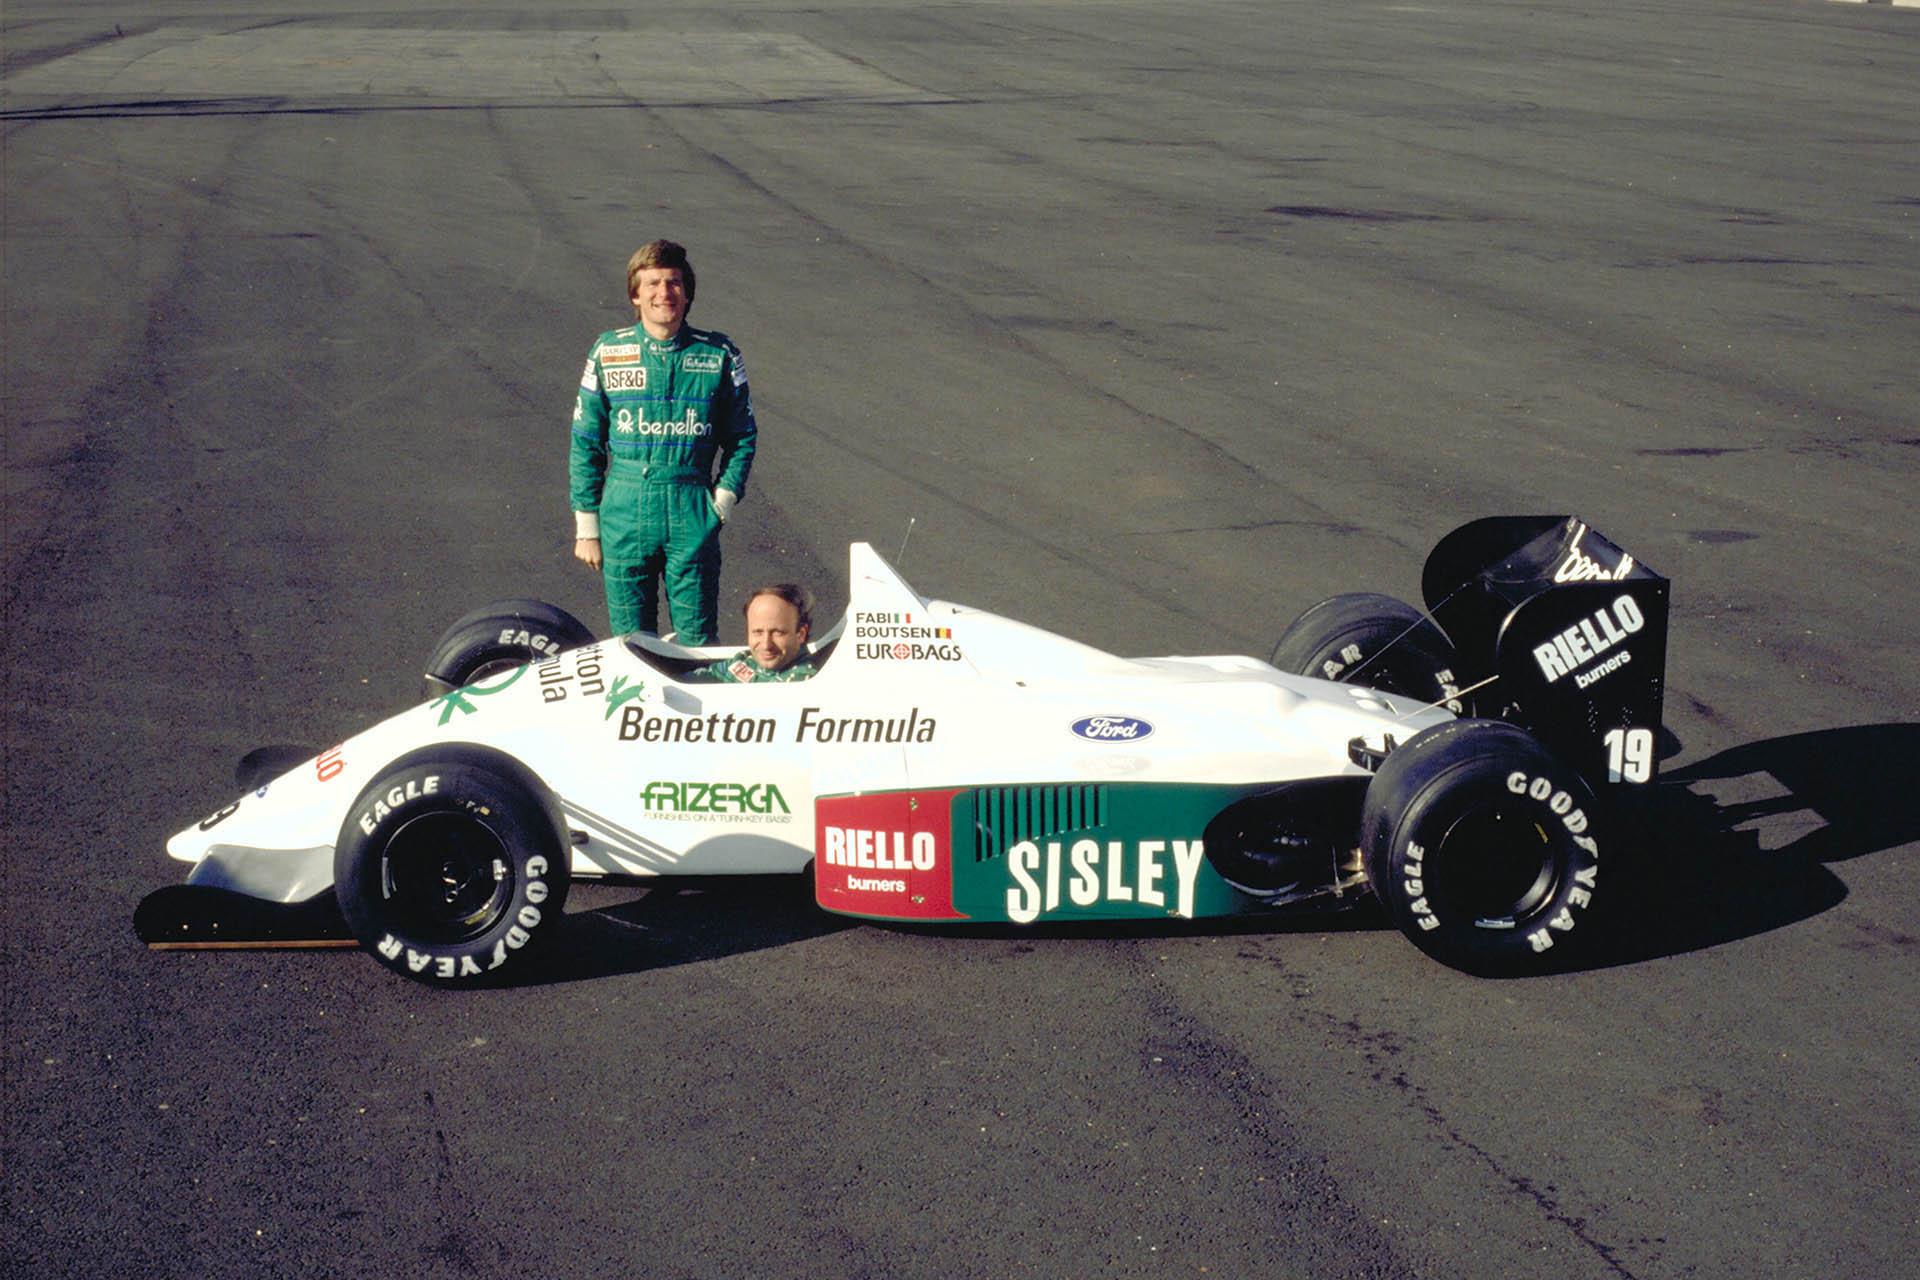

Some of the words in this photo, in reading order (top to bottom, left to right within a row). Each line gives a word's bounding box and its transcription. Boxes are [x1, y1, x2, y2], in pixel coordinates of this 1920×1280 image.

[638, 408, 712, 436] benetton
[856, 613, 891, 623] FABI
[856, 627, 931, 638] BOUTSEN
[1533, 595, 1645, 682] RIELLO
[1575, 650, 1632, 689] burners
[618, 706, 776, 743] Benetton
[796, 708, 936, 743] Formula
[1085, 717, 1138, 738] Ford
[1604, 729, 1653, 783] 19
[359, 776, 440, 835] EAGLE
[825, 826, 935, 871] RIELLO
[1507, 772, 1598, 952] GOODYEAR
[848, 874, 906, 892] burners
[1007, 838, 1204, 924] SISLEY
[1405, 841, 1440, 931] EAGLE
[378, 856, 548, 977] GOODYEAR
